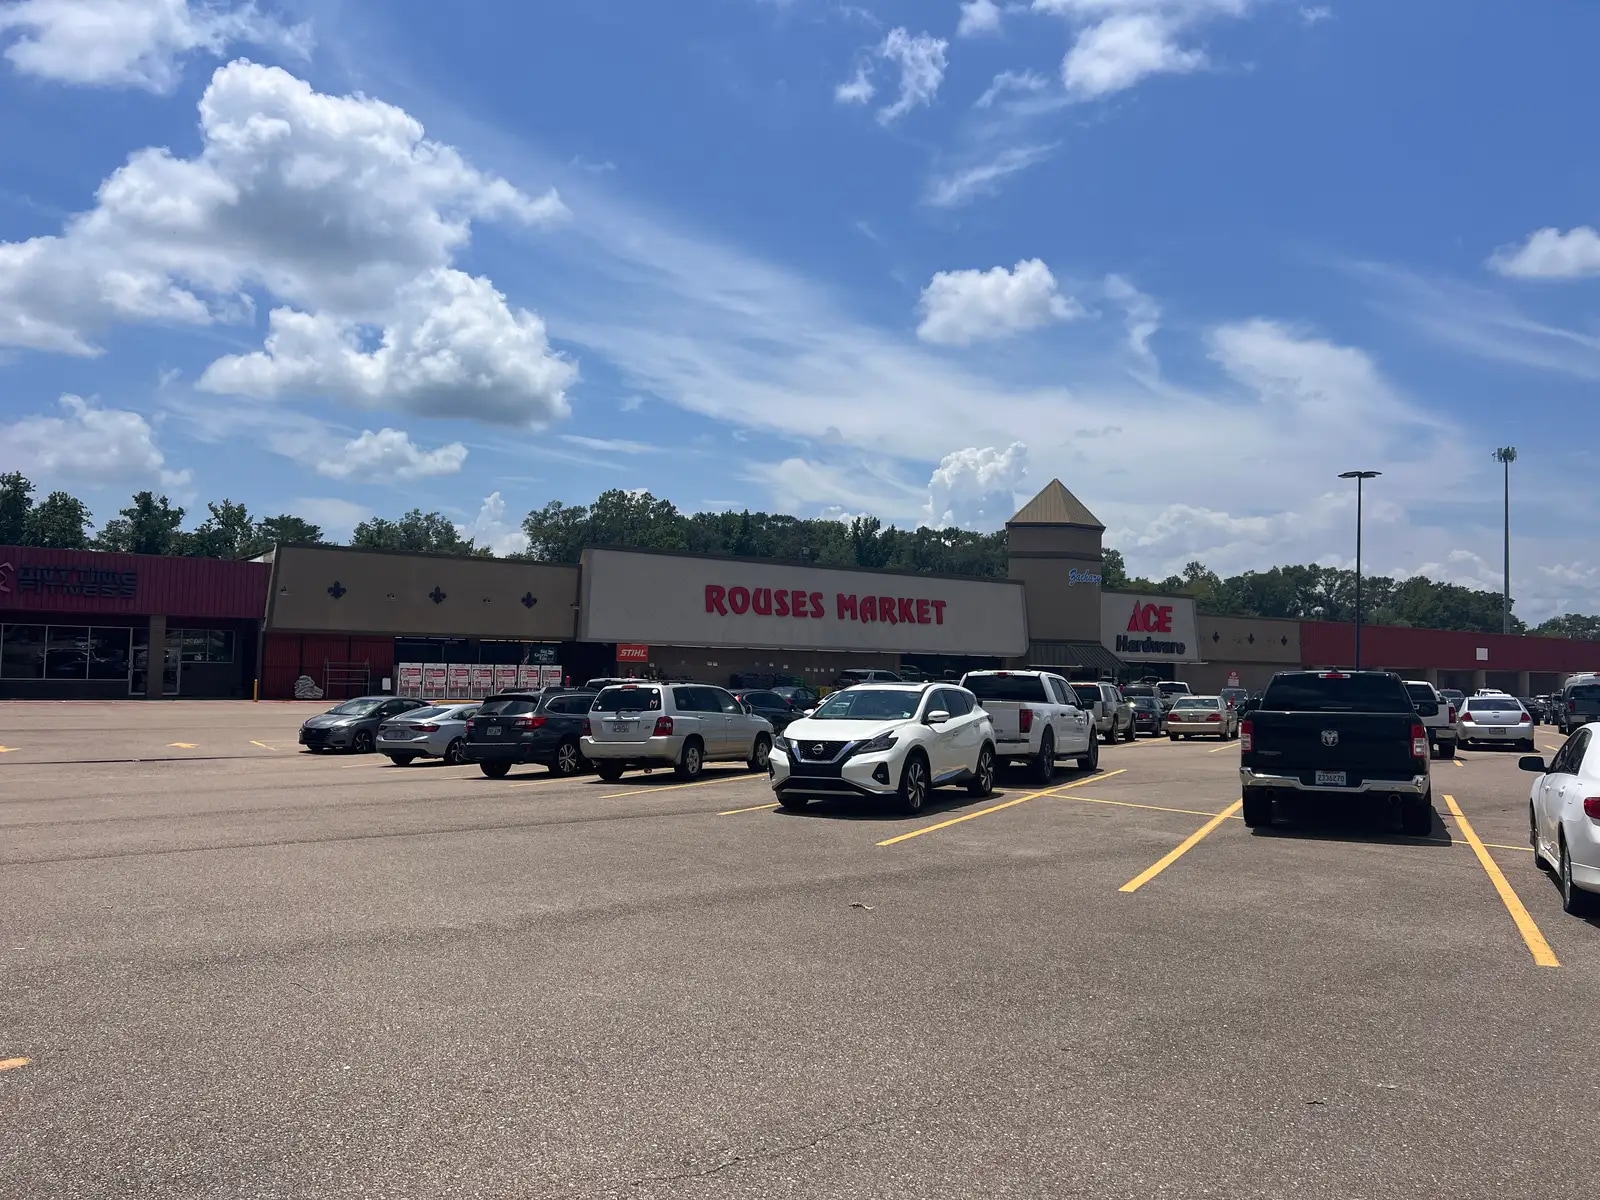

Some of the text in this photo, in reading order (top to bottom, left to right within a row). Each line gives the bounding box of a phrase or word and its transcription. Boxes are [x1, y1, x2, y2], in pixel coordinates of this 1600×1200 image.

[18, 581, 137, 598] FITNESS
[705, 585, 947, 626] ROUSES MARKET
[1127, 600, 1173, 632] ACE
[620, 649, 646, 657] STIHL
[1116, 634, 1186, 655] Hardware
